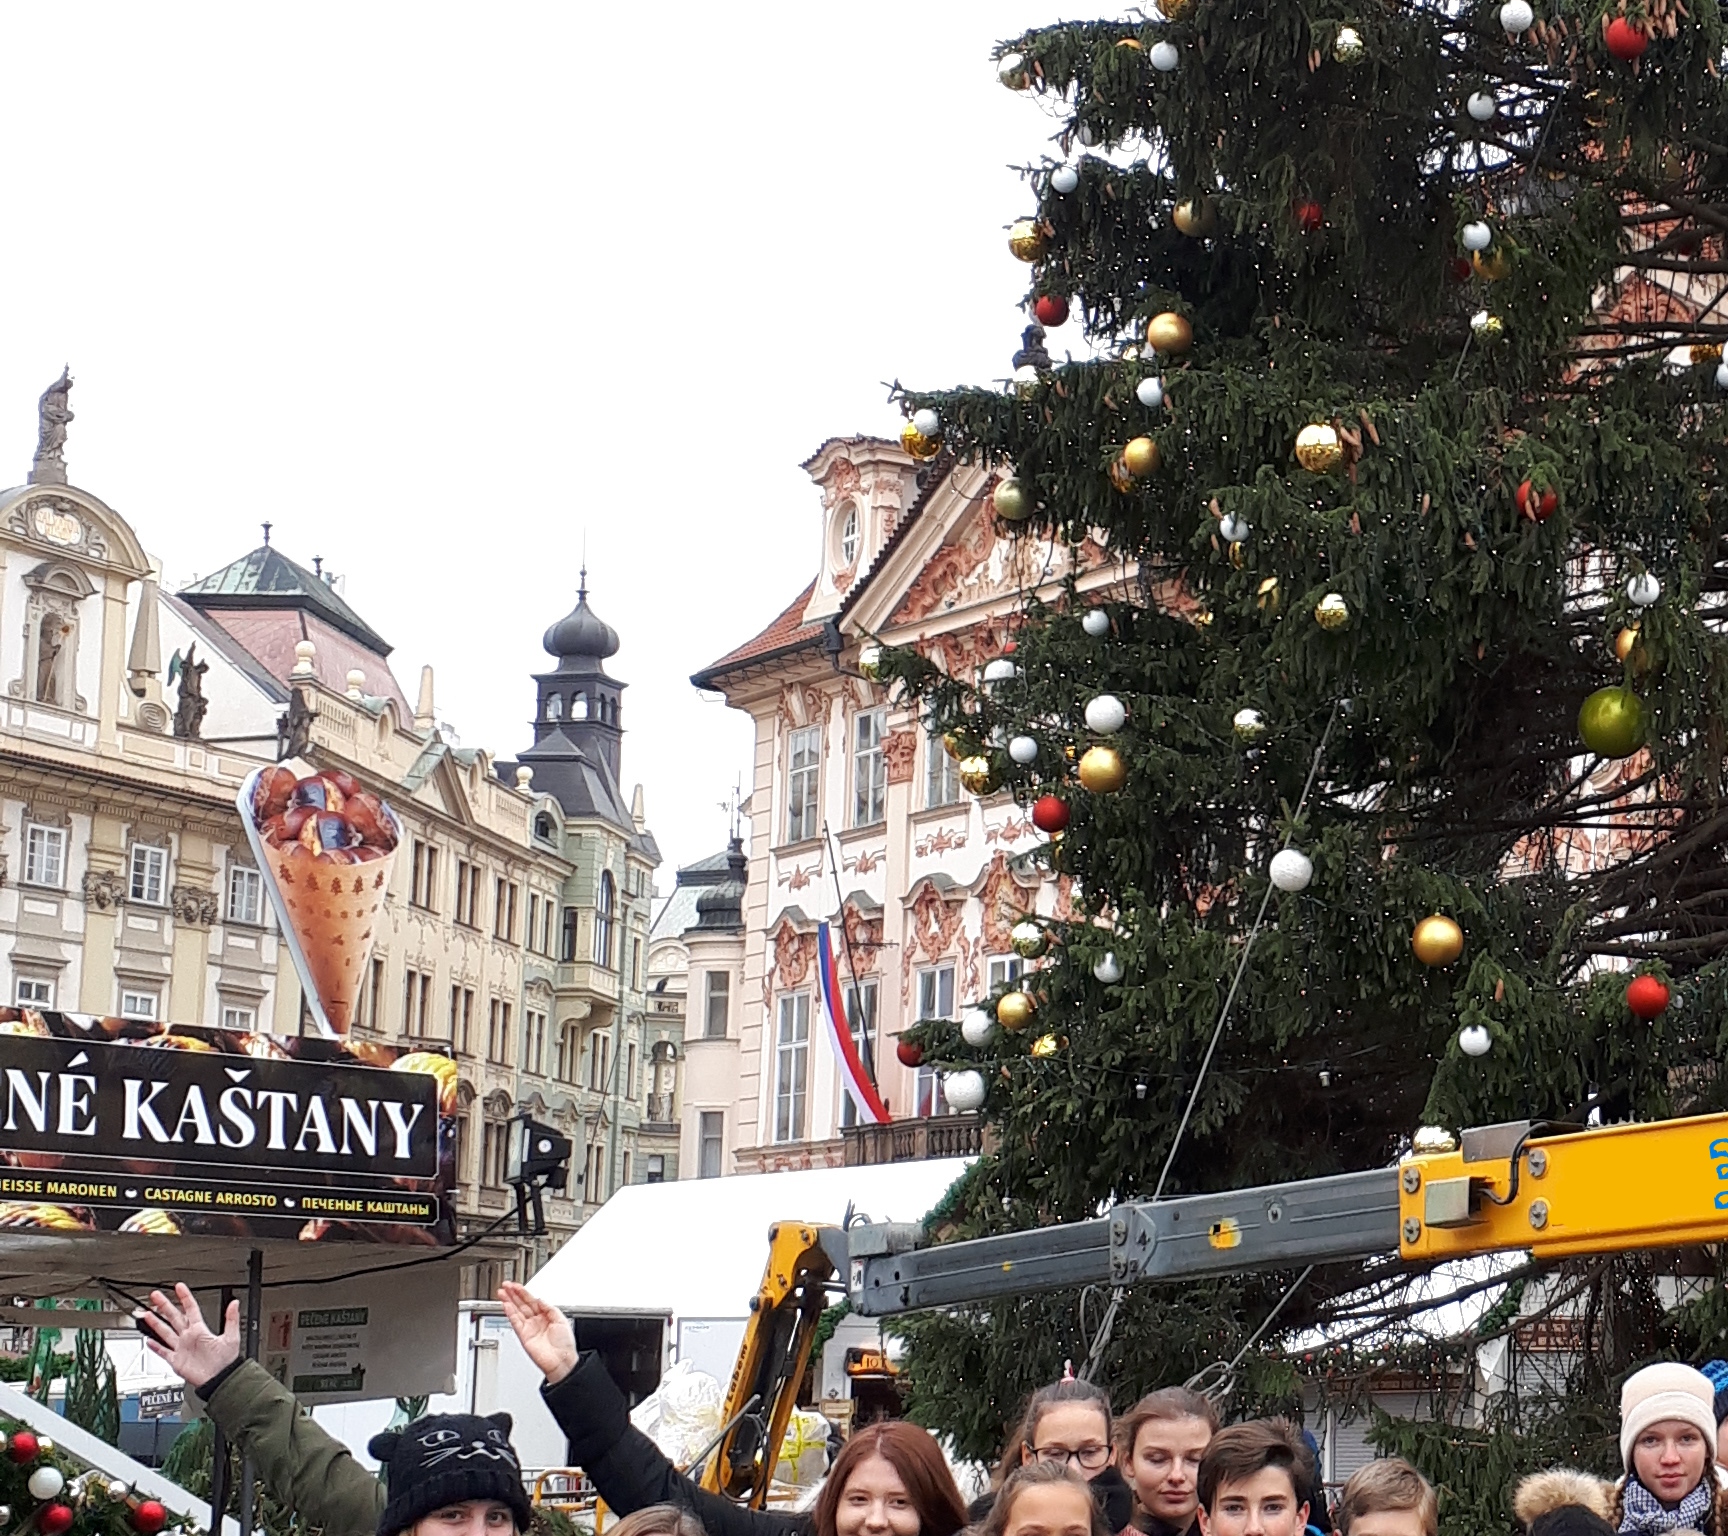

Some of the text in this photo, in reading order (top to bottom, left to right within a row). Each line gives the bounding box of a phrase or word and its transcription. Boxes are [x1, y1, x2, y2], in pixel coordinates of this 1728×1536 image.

[122, 1066, 425, 1159] KAŠTANY
[0, 1178, 118, 1198] EISSE MARONEN
[144, 1187, 277, 1207] CASTAGNE ARROSTO
[302, 1197, 430, 1216] ПЕЧЕНЫЕ КАШТАНЫ
